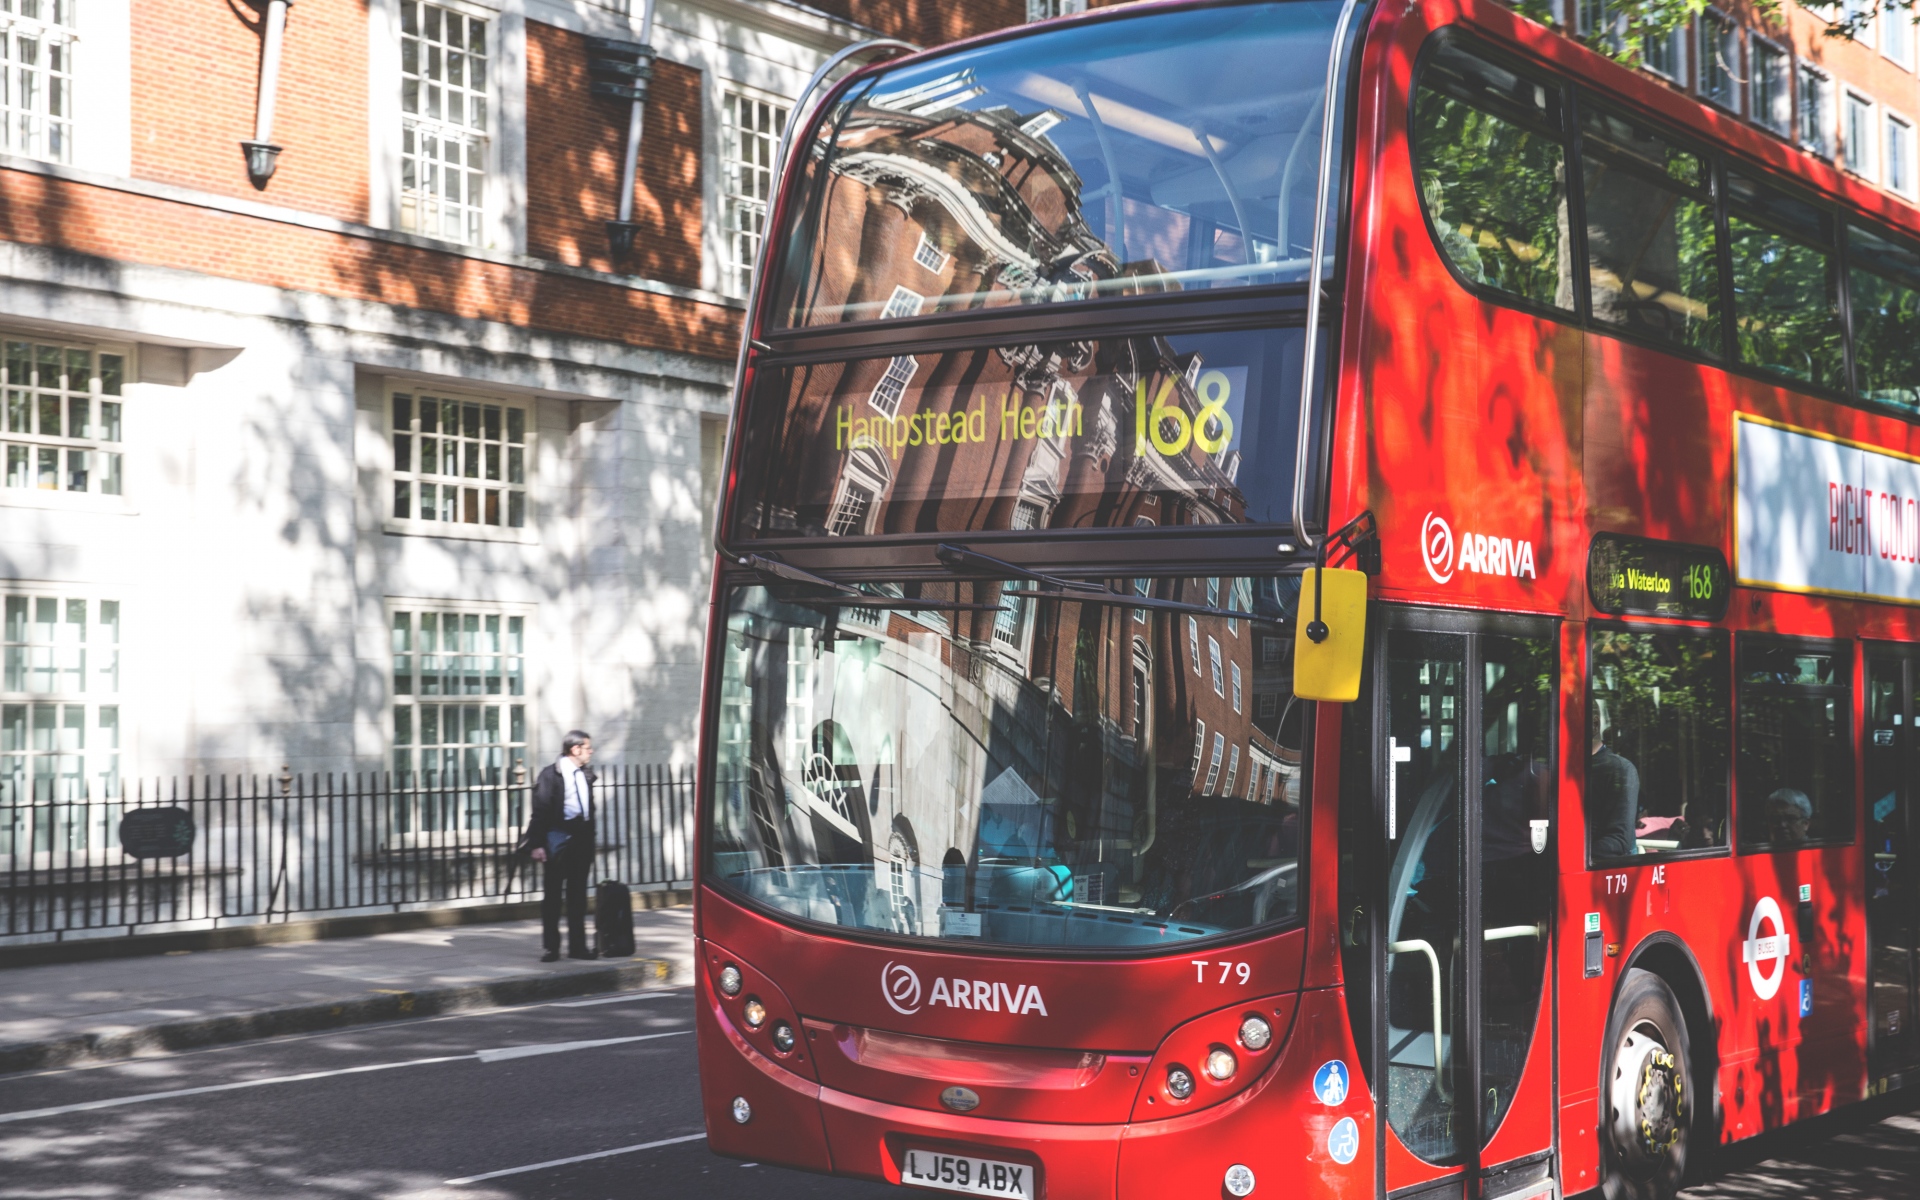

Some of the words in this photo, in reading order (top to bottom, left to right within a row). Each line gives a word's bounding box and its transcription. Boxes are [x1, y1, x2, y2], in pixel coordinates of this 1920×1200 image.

[835, 394, 986, 459] Hampstead
[1000, 392, 1083, 440] Heath
[1134, 370, 1234, 457] 168
[1828, 481, 1872, 556] RIGHT
[1880, 492, 1920, 565] COLO
[1457, 531, 1537, 580] ARRIVA
[1627, 567, 1671, 594] Waterloo
[1690, 564, 1712, 600] 168
[1605, 875, 1613, 895] T
[1615, 873, 1628, 894] 79
[1651, 864, 1666, 885] AE
[1191, 960, 1209, 983] T
[1218, 961, 1251, 985] 79
[928, 976, 1049, 1017] ARRIVA
[910, 1152, 971, 1186] LJ59
[978, 1162, 1023, 1194] ABX
